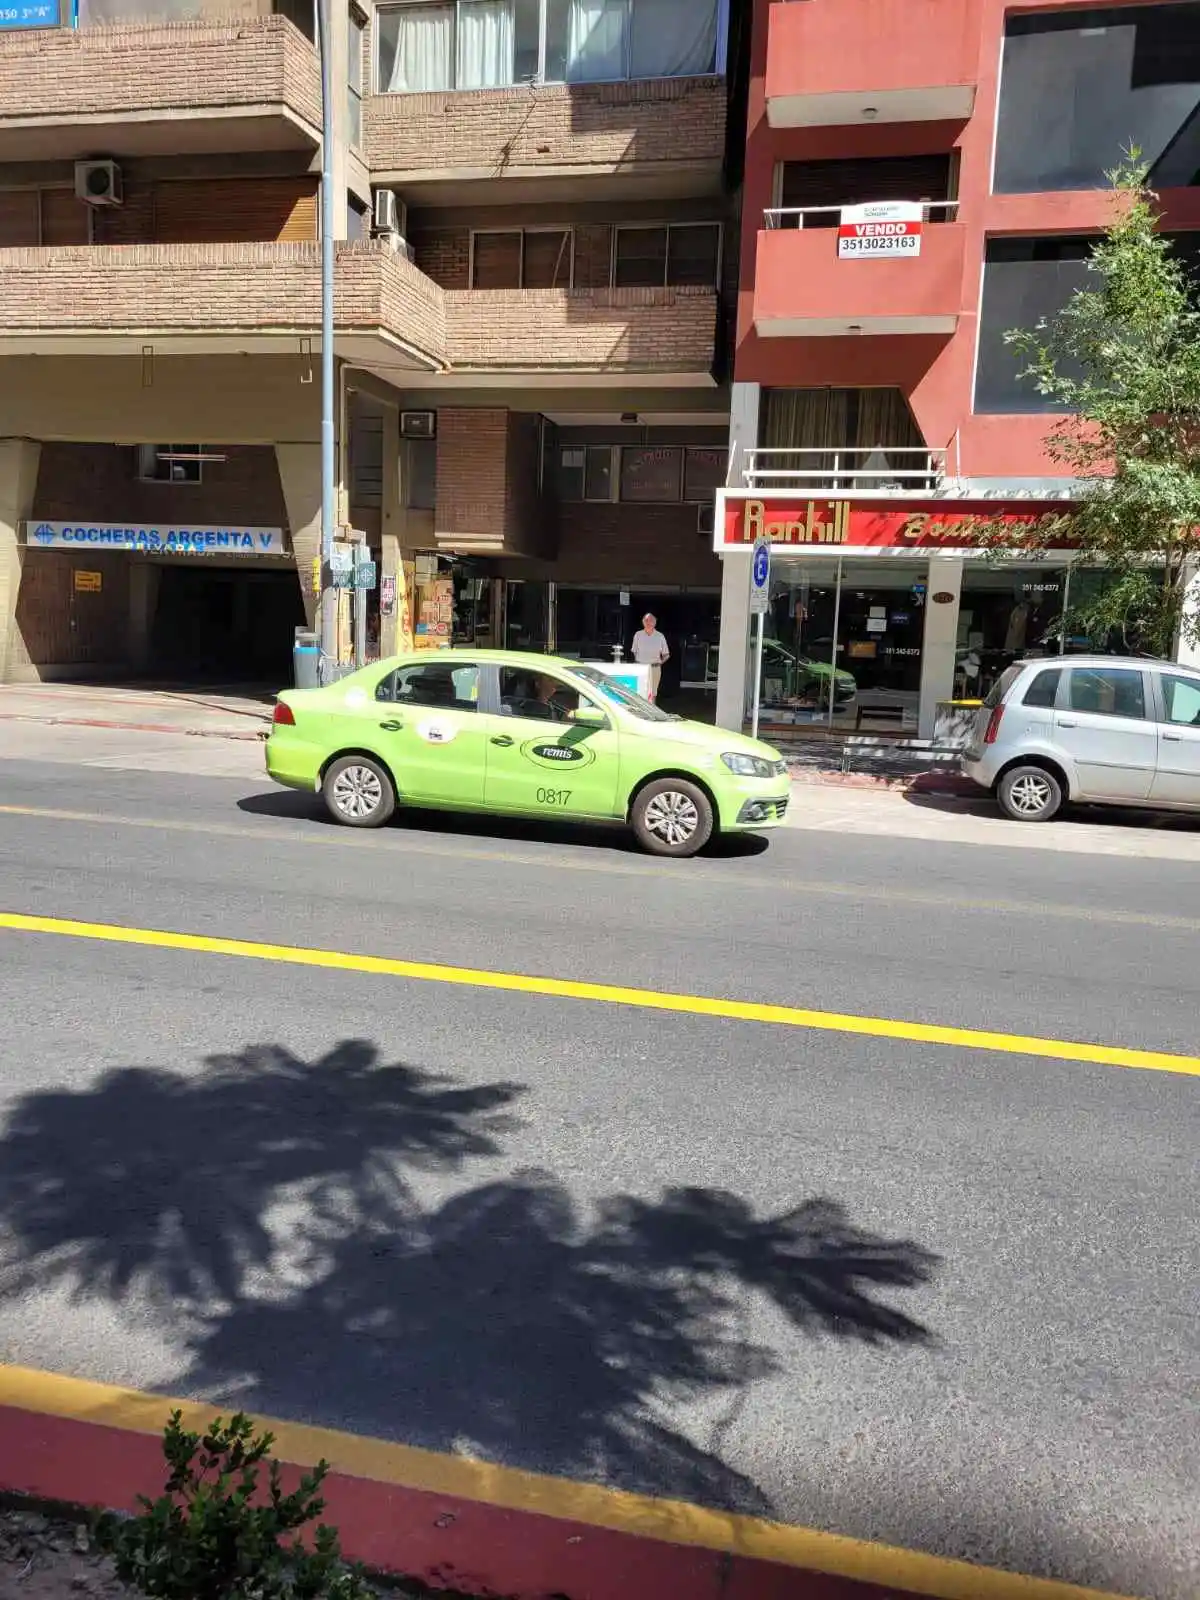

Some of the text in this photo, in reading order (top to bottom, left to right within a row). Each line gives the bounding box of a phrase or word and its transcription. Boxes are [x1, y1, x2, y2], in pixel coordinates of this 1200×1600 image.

[856, 223, 907, 236] VENDO
[842, 237, 916, 250] 3513023163
[744, 499, 850, 542] Ranhill
[62, 527, 272, 547] COCHERAS ARGENTA V
[543, 748, 573, 759] remis
[536, 788, 573, 805] 0817
